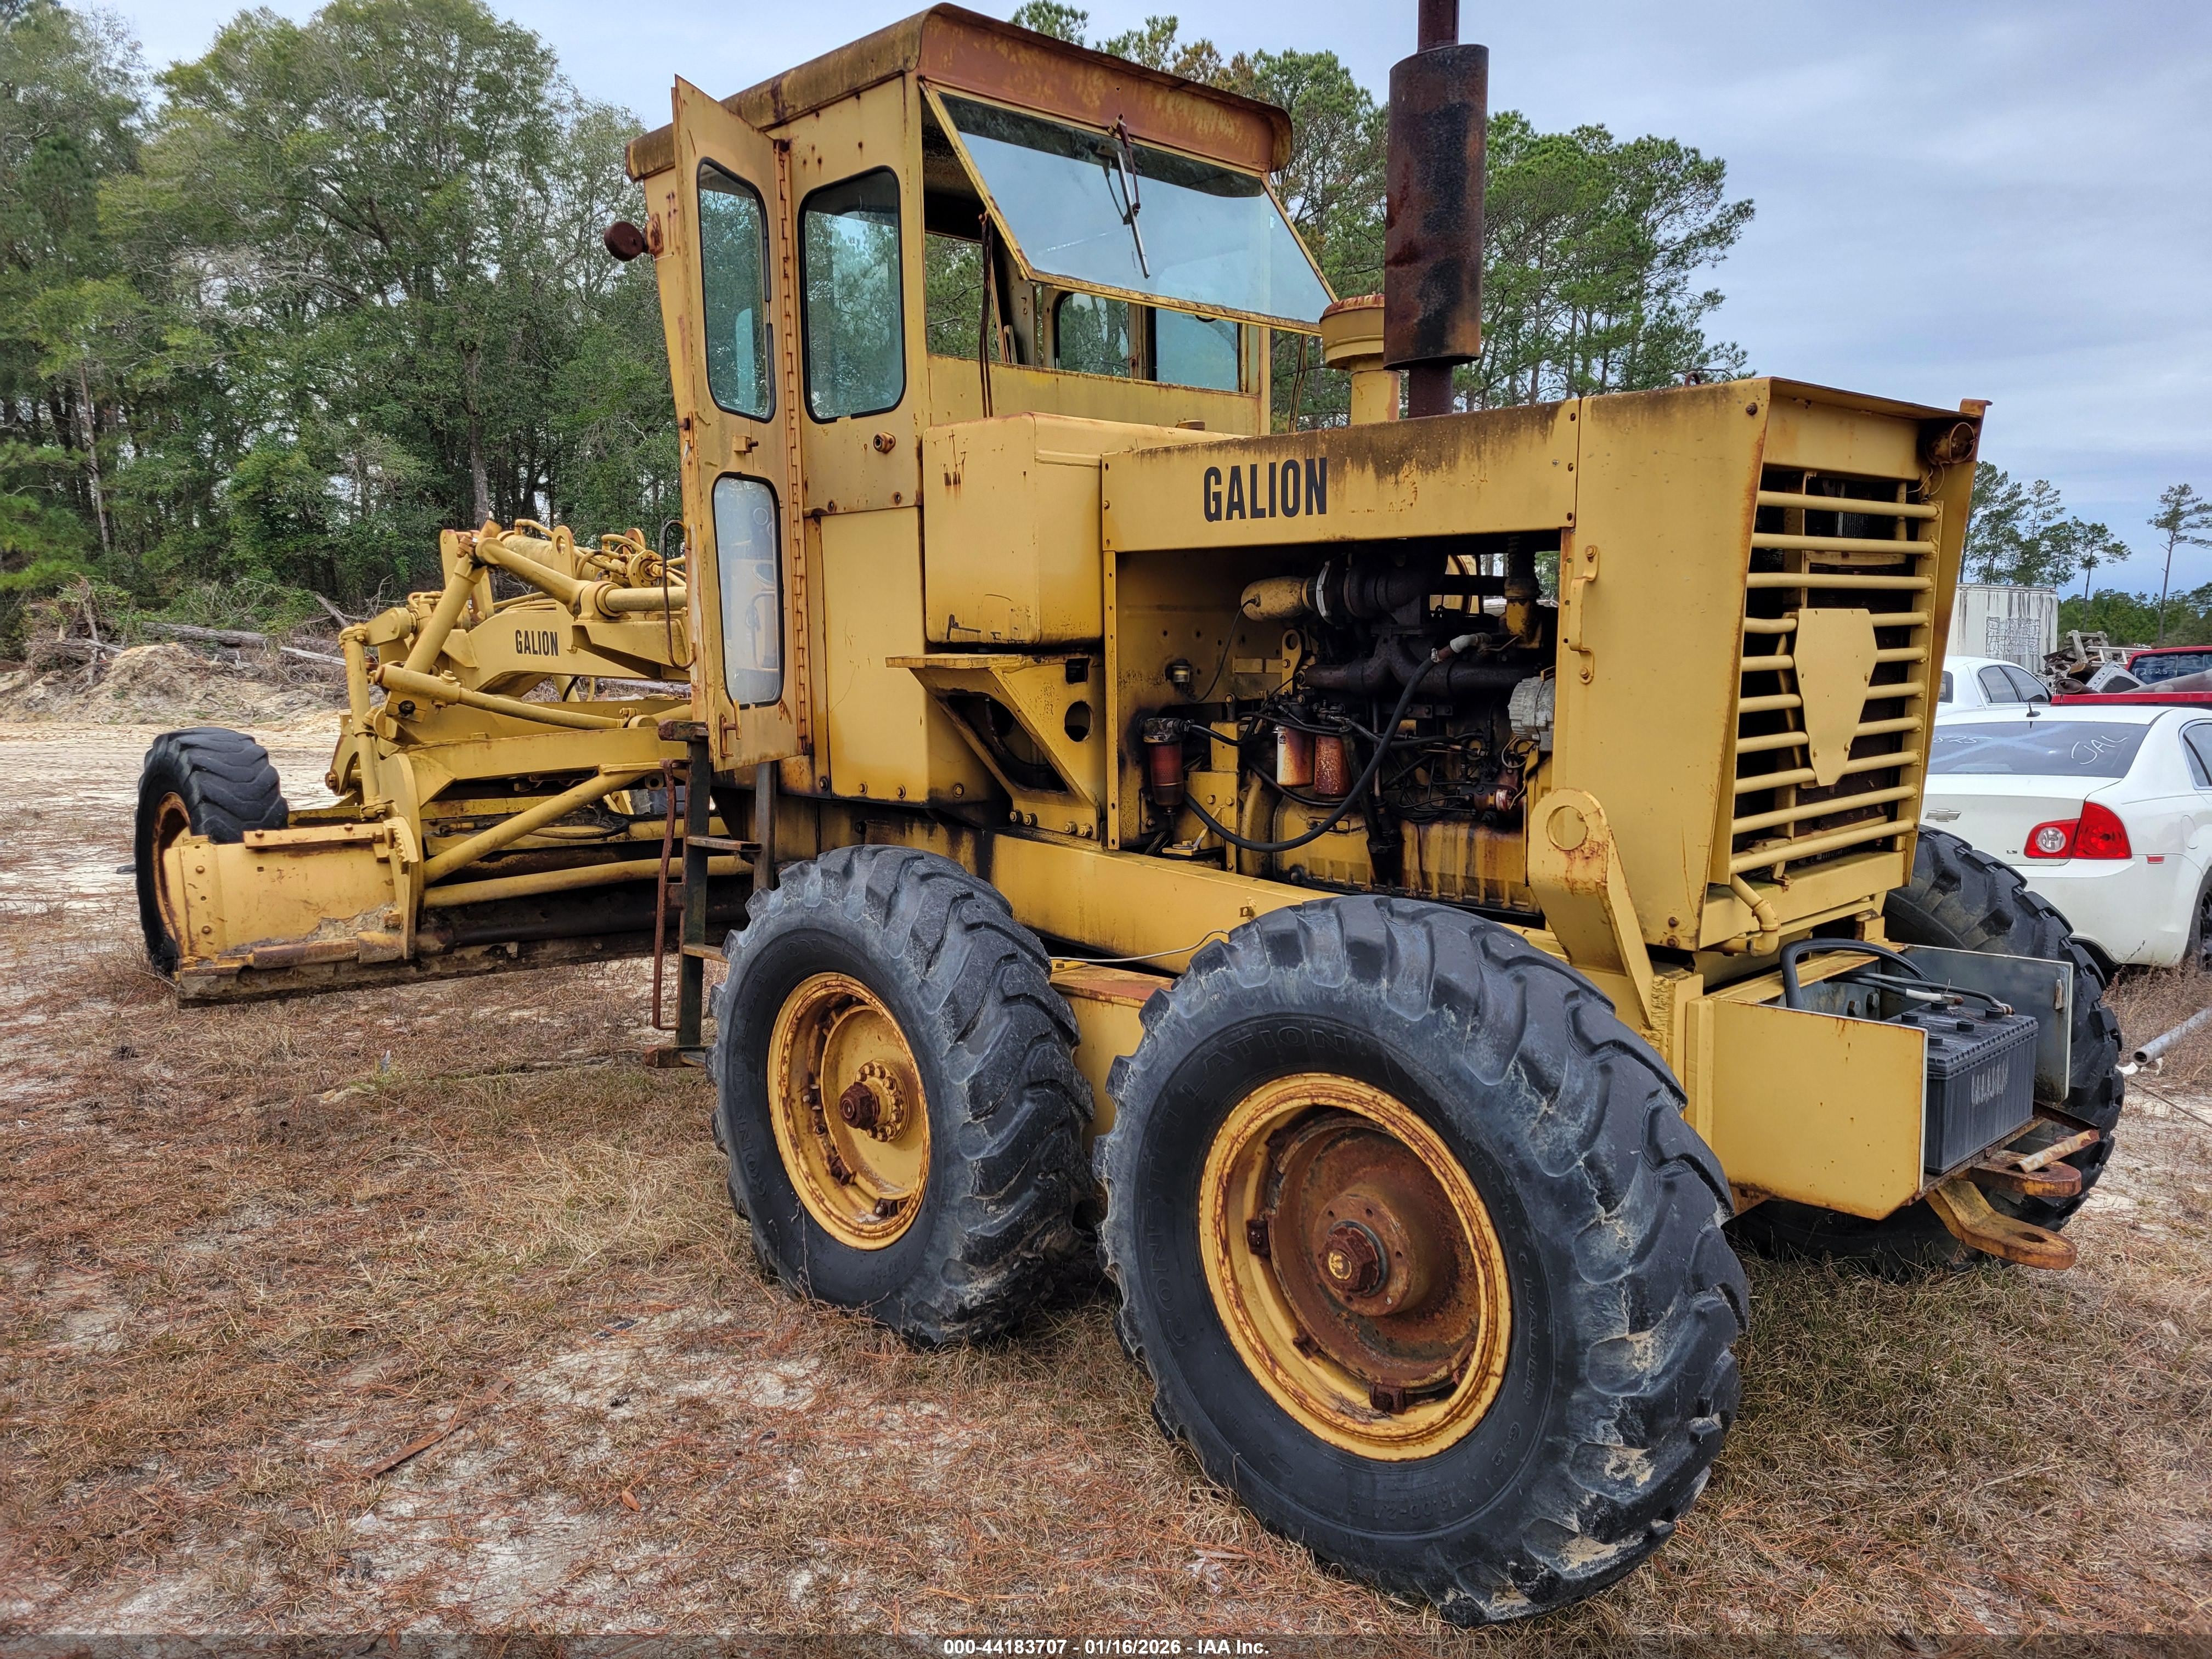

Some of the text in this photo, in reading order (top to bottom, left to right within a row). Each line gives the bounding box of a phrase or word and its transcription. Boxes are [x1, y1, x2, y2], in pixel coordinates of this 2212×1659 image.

[1204, 457, 1327, 522] GALION
[515, 629, 559, 657] GALION
[1147, 1026, 1350, 1348] CONSTELLATION
[1492, 1423, 1522, 1466] G-2
